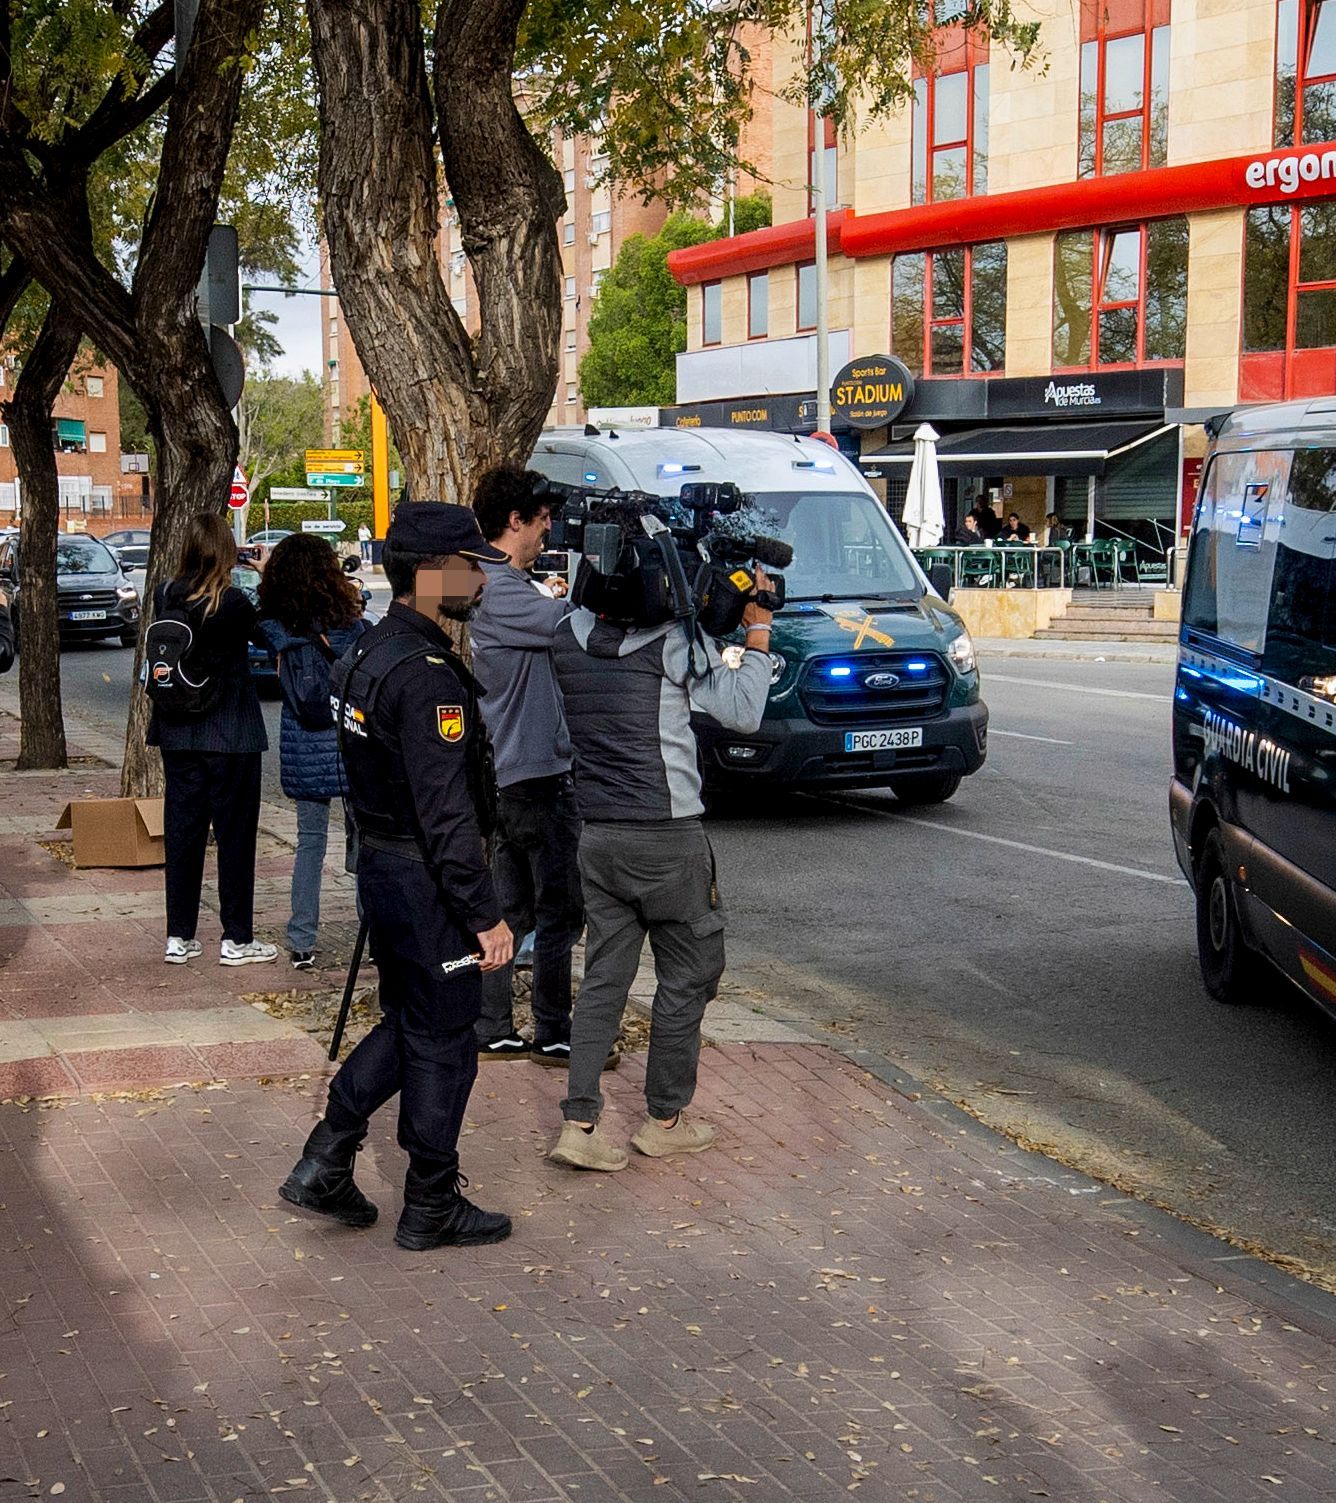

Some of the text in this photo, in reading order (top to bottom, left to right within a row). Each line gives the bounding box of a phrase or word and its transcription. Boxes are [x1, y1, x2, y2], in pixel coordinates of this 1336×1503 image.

[851, 366, 887, 379] Sports Bar
[836, 382, 903, 406] STADIUM
[1044, 381, 1096, 406] Apuestas
[731, 408, 768, 424] PUNTO COM
[853, 733, 877, 750] PGC
[879, 731, 910, 748] 2438
[1203, 709, 1291, 793] GUARDIA CIVIL
